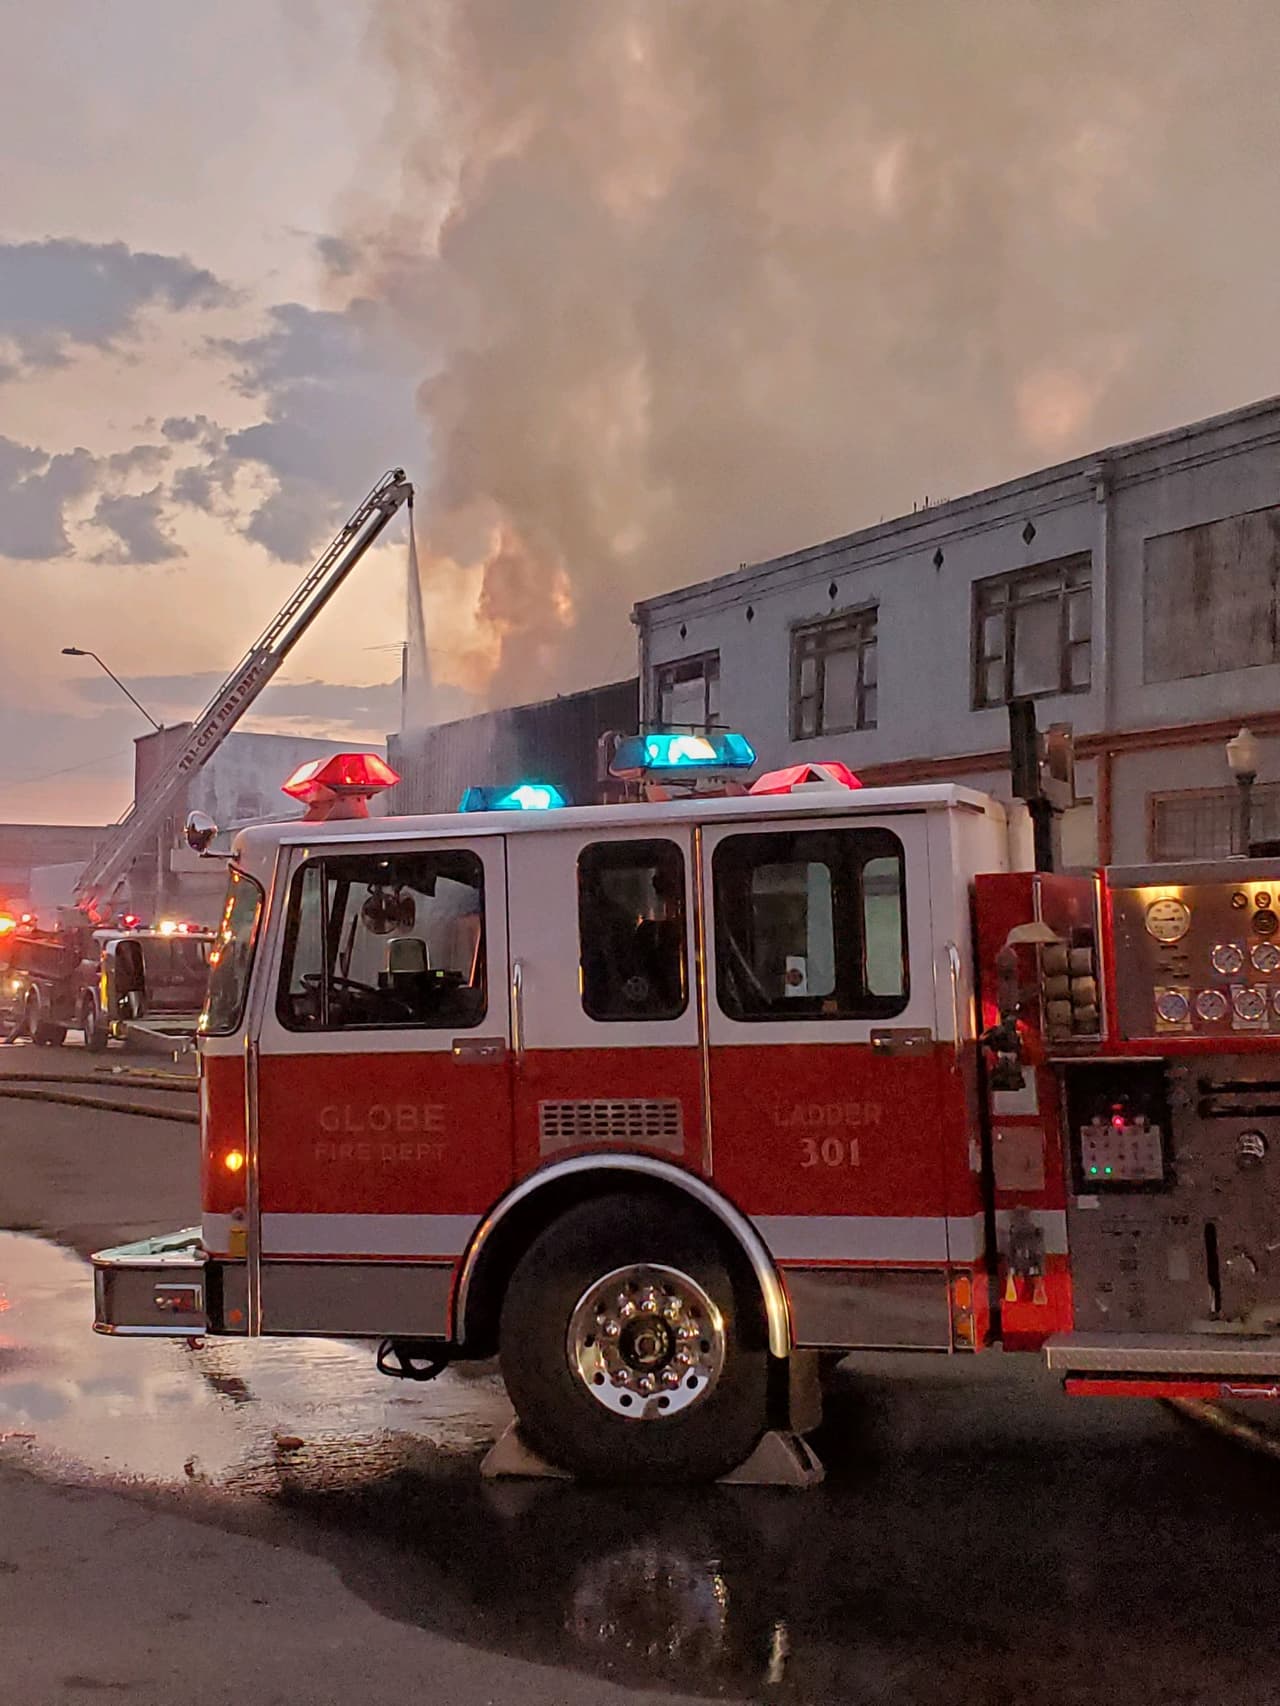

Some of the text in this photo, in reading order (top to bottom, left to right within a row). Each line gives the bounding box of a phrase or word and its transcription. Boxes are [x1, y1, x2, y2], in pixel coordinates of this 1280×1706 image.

[217, 695, 240, 721] FIRE
[319, 1104, 447, 1132] GLOBE
[774, 1103, 882, 1126] LADDER
[315, 1143, 448, 1161] FIRE DEPT
[800, 1137, 861, 1167] 301
